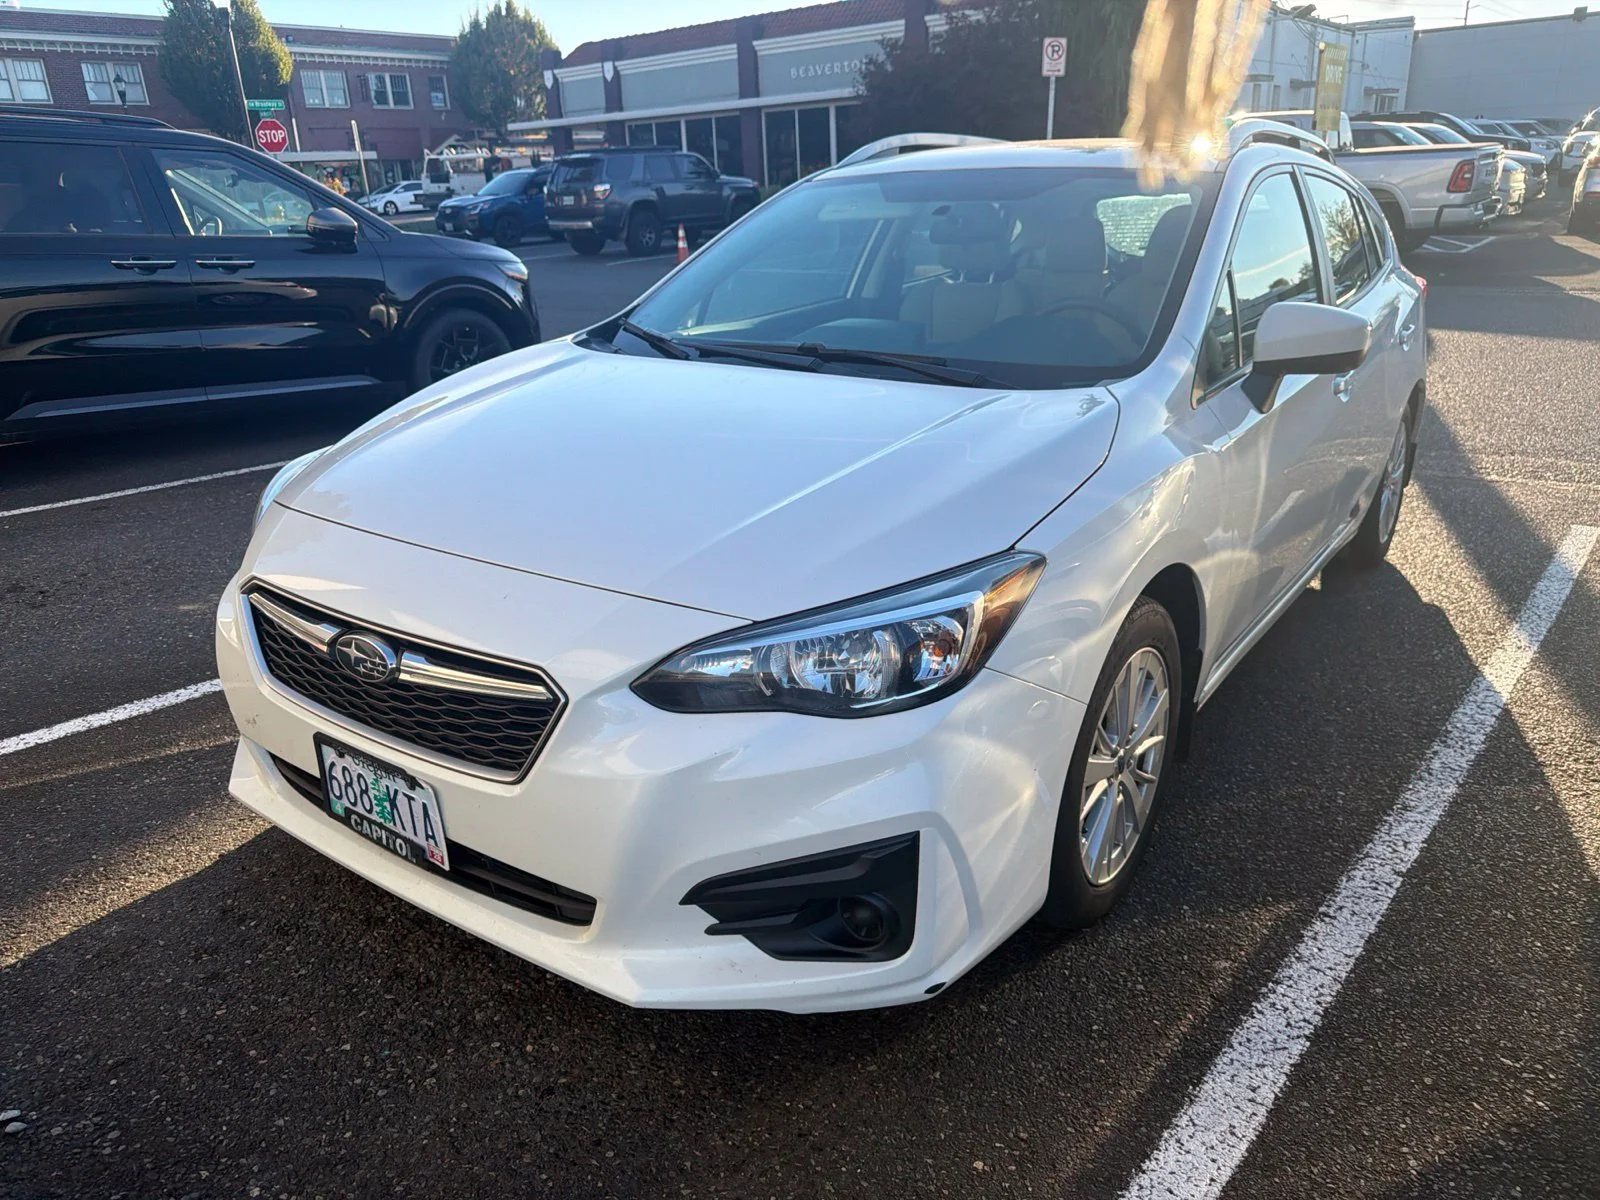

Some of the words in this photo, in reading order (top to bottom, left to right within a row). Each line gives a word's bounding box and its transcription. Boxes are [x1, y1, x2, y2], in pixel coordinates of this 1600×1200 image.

[259, 130, 285, 143] STOP
[328, 761, 374, 814] 688
[386, 783, 440, 847] KTA
[350, 814, 417, 863] CAPITOL
